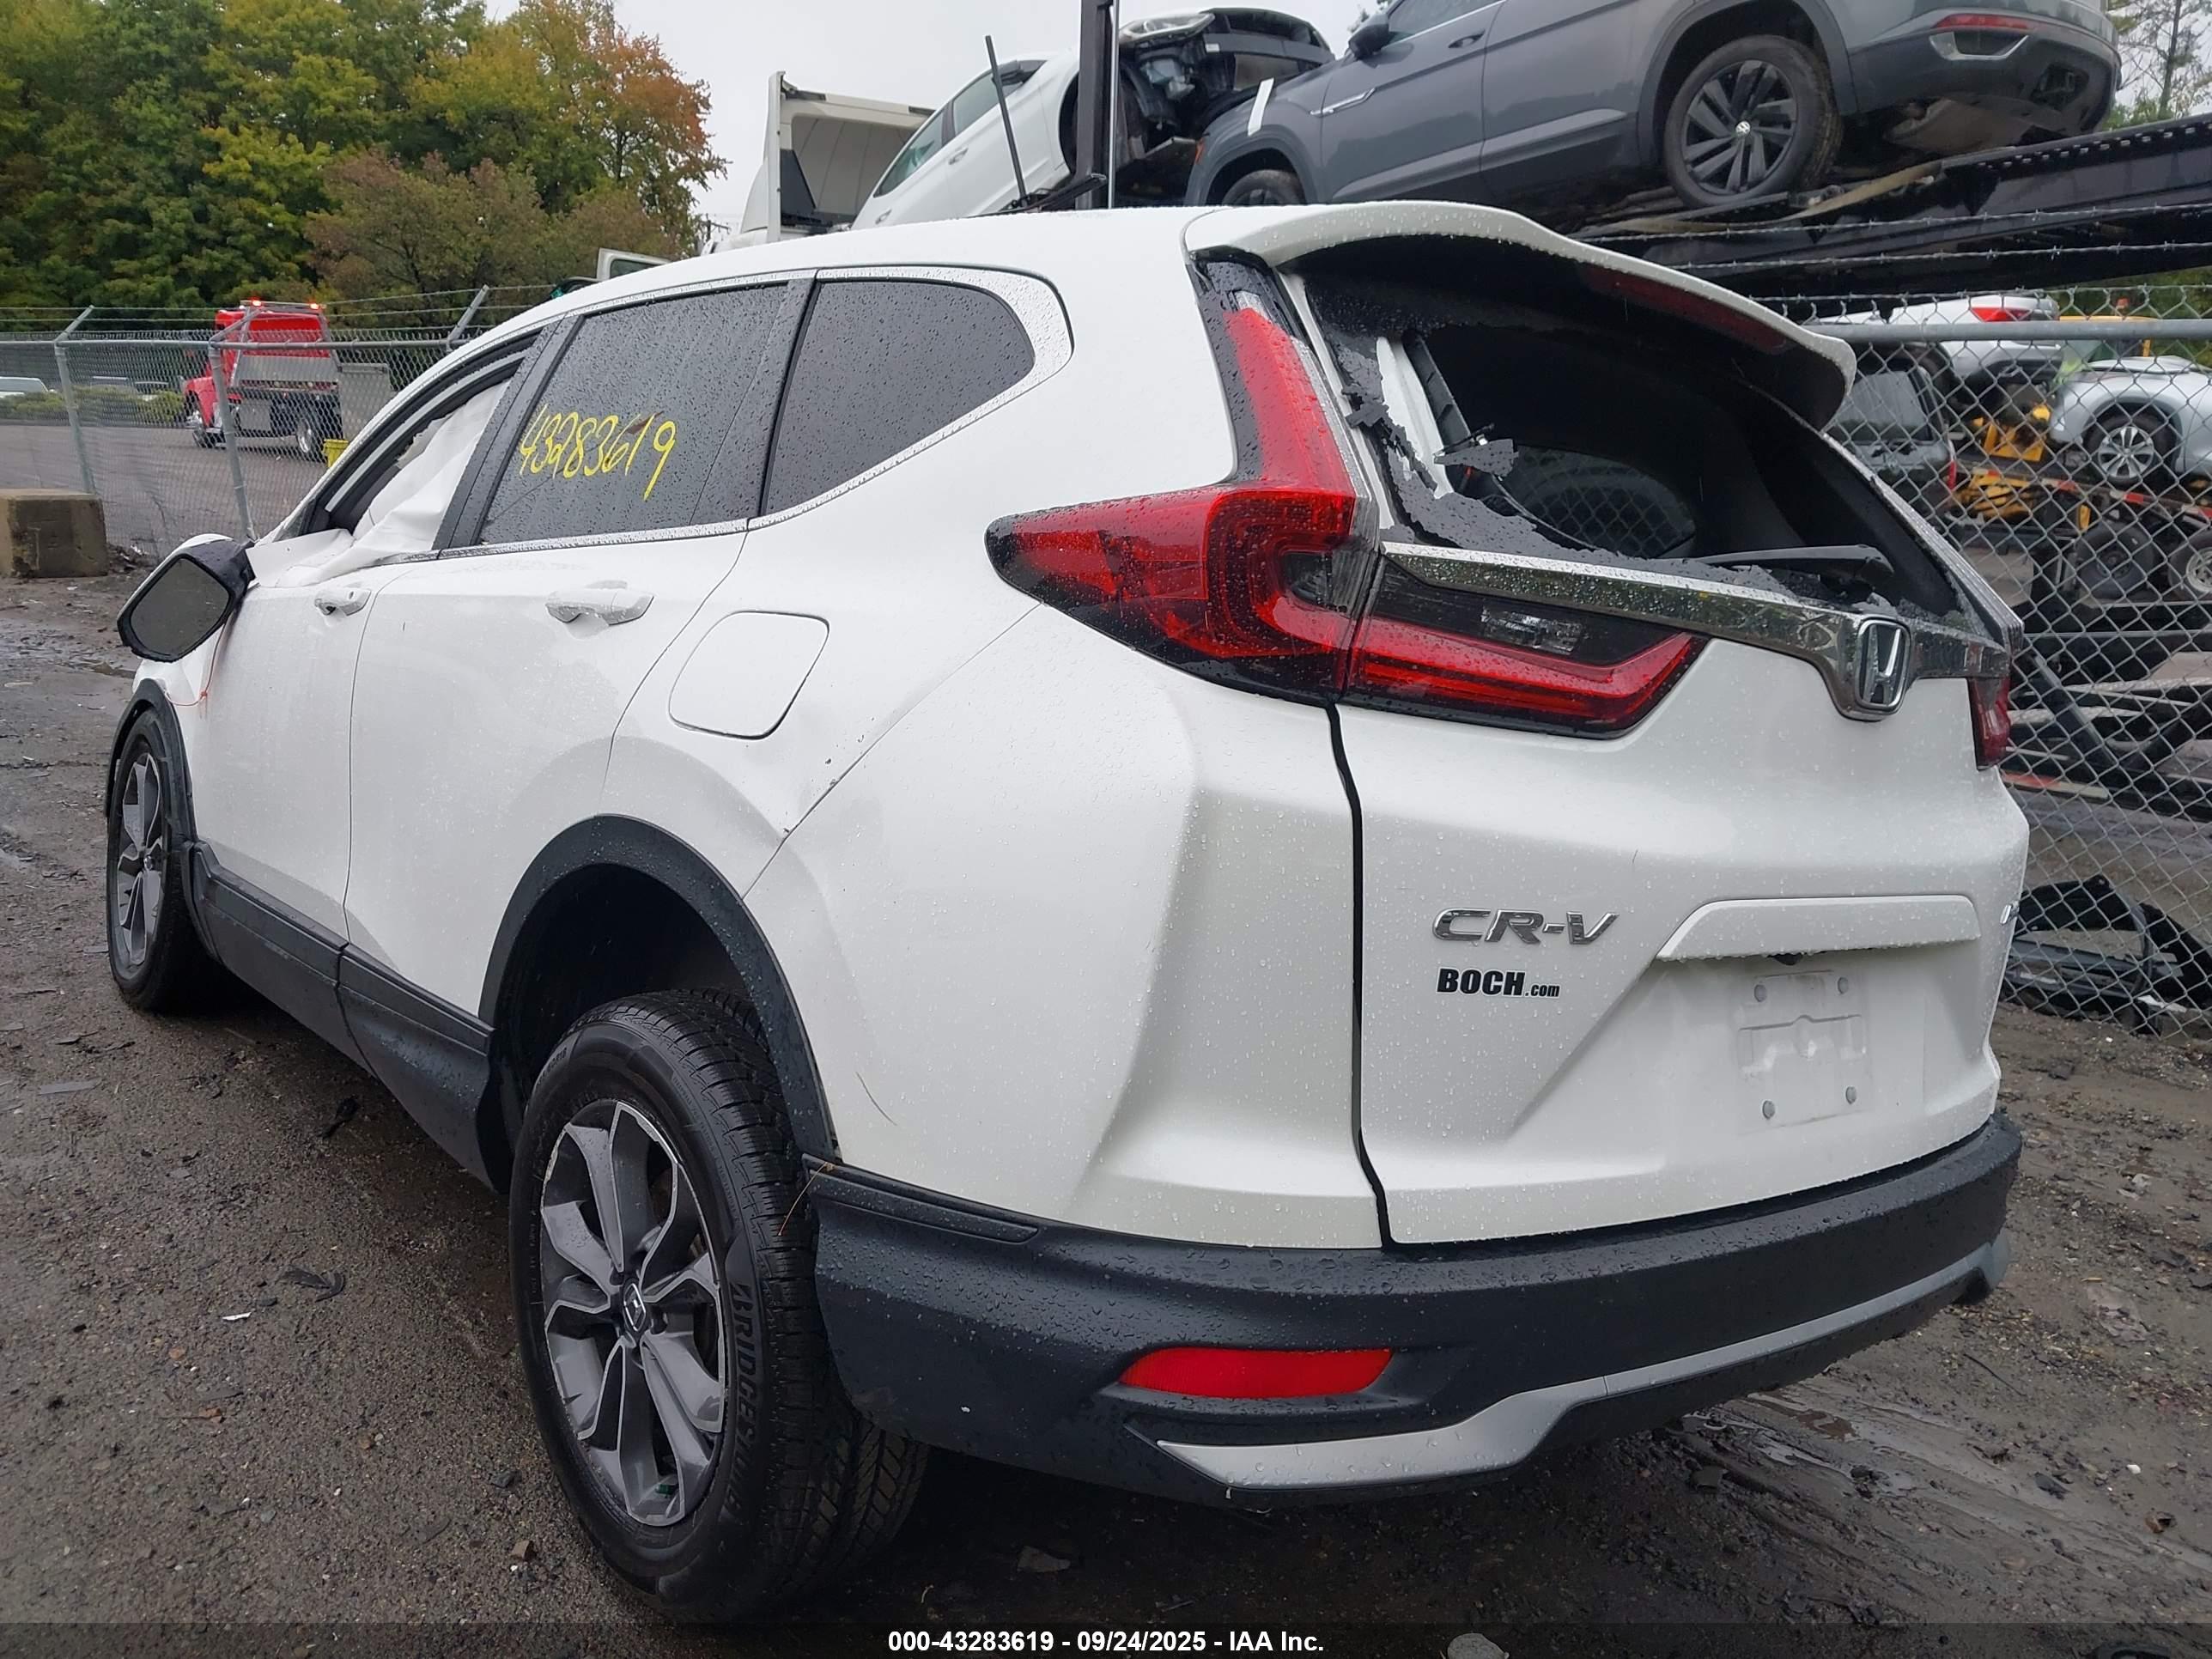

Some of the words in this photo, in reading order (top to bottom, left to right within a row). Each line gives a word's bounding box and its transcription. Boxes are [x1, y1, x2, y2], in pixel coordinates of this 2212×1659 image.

[520, 403, 677, 501] 43283619
[1432, 907, 1620, 945] CR-V
[1437, 968, 1560, 997] BOCH.com
